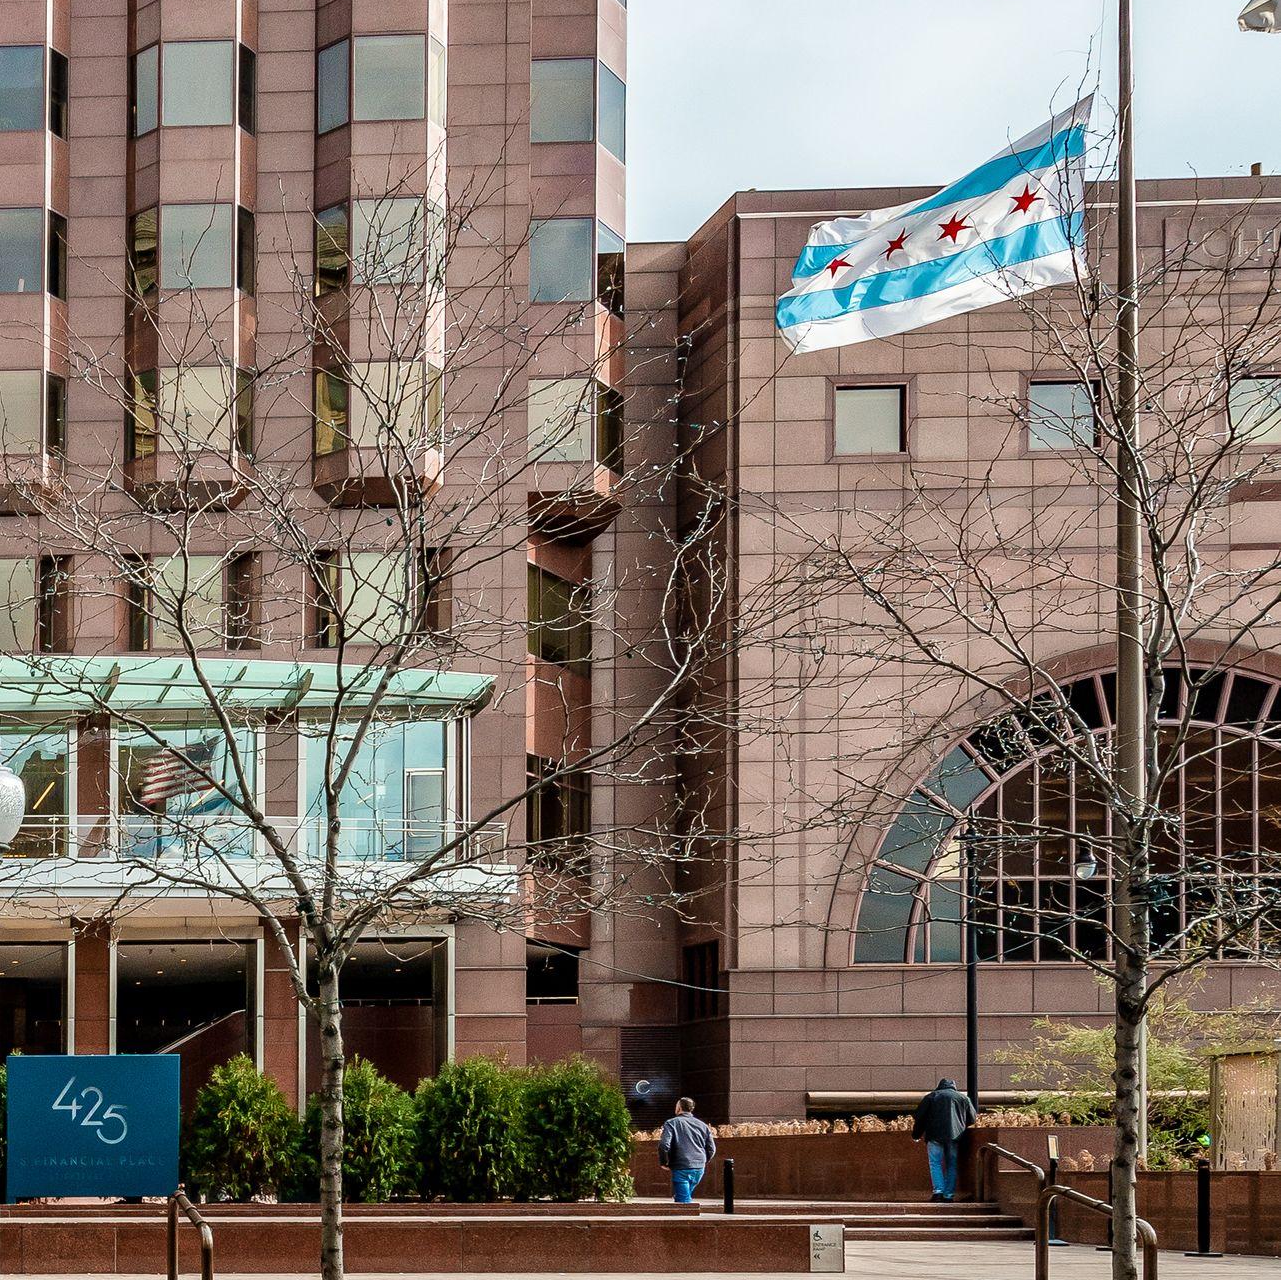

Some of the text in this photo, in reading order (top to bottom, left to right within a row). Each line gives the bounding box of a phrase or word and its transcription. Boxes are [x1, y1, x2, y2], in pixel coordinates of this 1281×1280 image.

[51, 1076, 129, 1145] 425
[34, 1155, 113, 1167] FINANCIAL
[119, 1155, 167, 1167] PLACE
